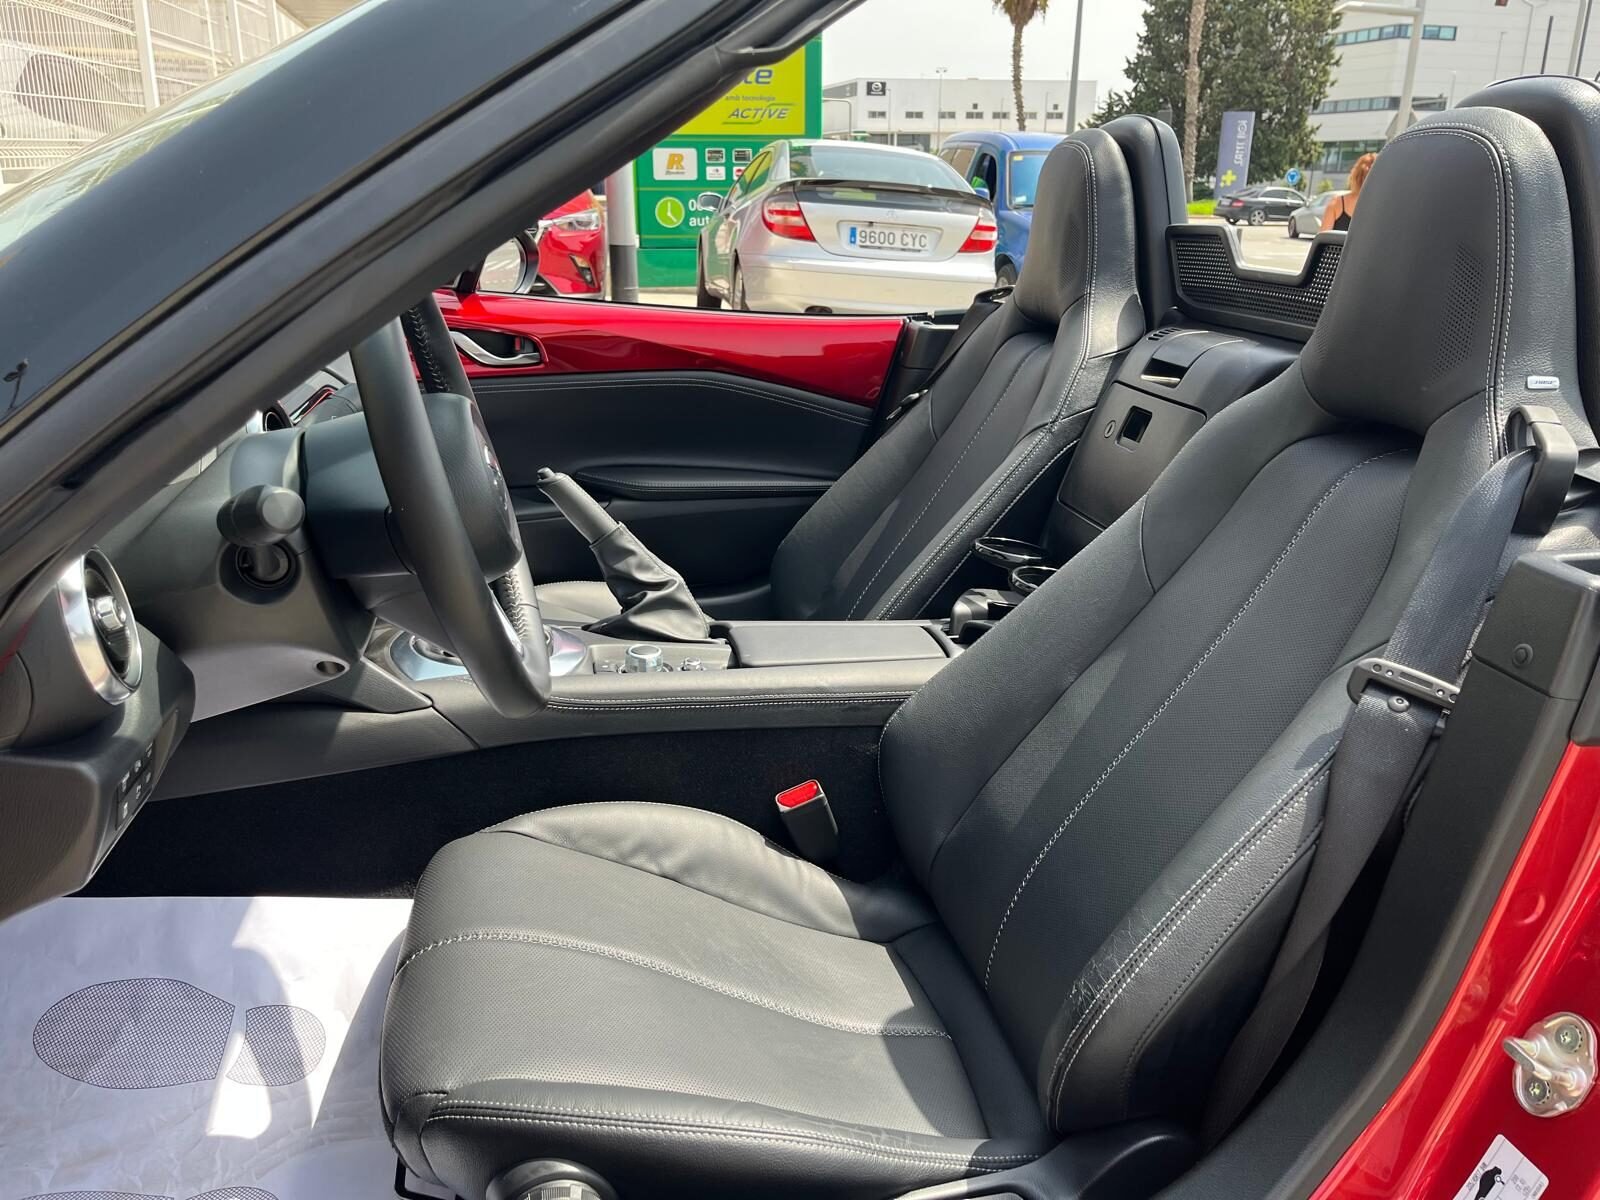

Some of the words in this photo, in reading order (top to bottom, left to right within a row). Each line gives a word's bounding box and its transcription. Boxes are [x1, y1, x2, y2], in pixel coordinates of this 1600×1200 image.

[728, 108, 788, 119] ACTIVE
[667, 153, 684, 170] R
[859, 231, 895, 245] 9600
[901, 233, 927, 248] CYC
